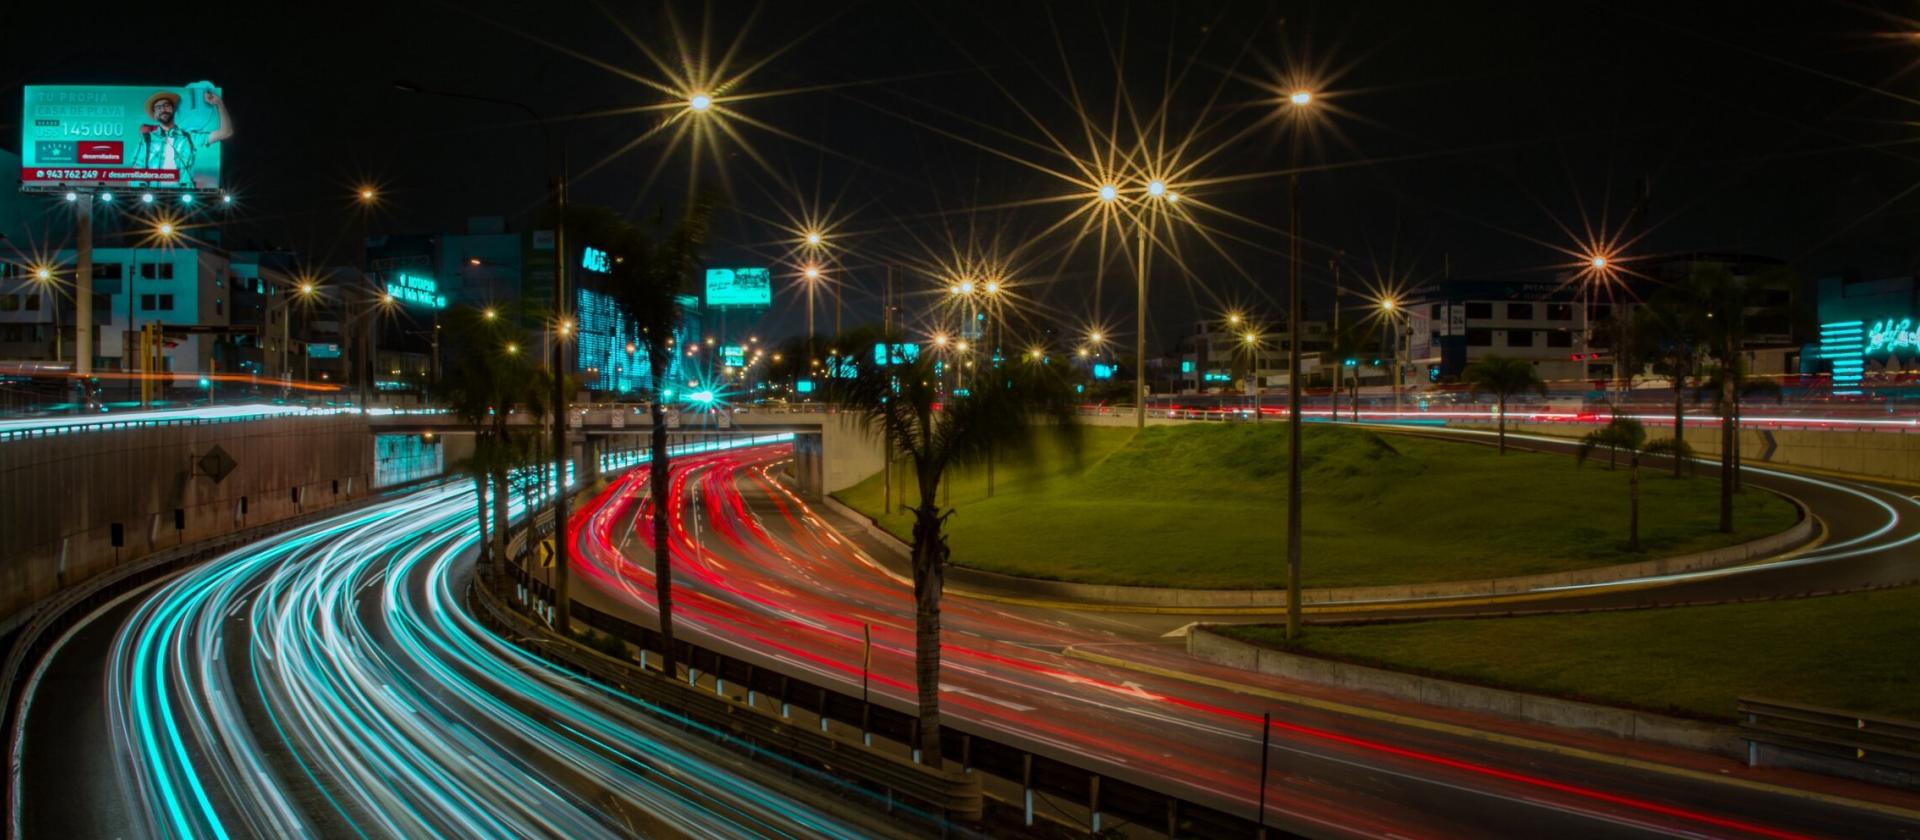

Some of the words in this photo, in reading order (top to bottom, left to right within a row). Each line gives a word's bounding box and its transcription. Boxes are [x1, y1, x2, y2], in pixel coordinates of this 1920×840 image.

[60, 92, 108, 102] PROPIA
[46, 170, 63, 179] 943
[108, 170, 175, 179] desarrolladora.com
